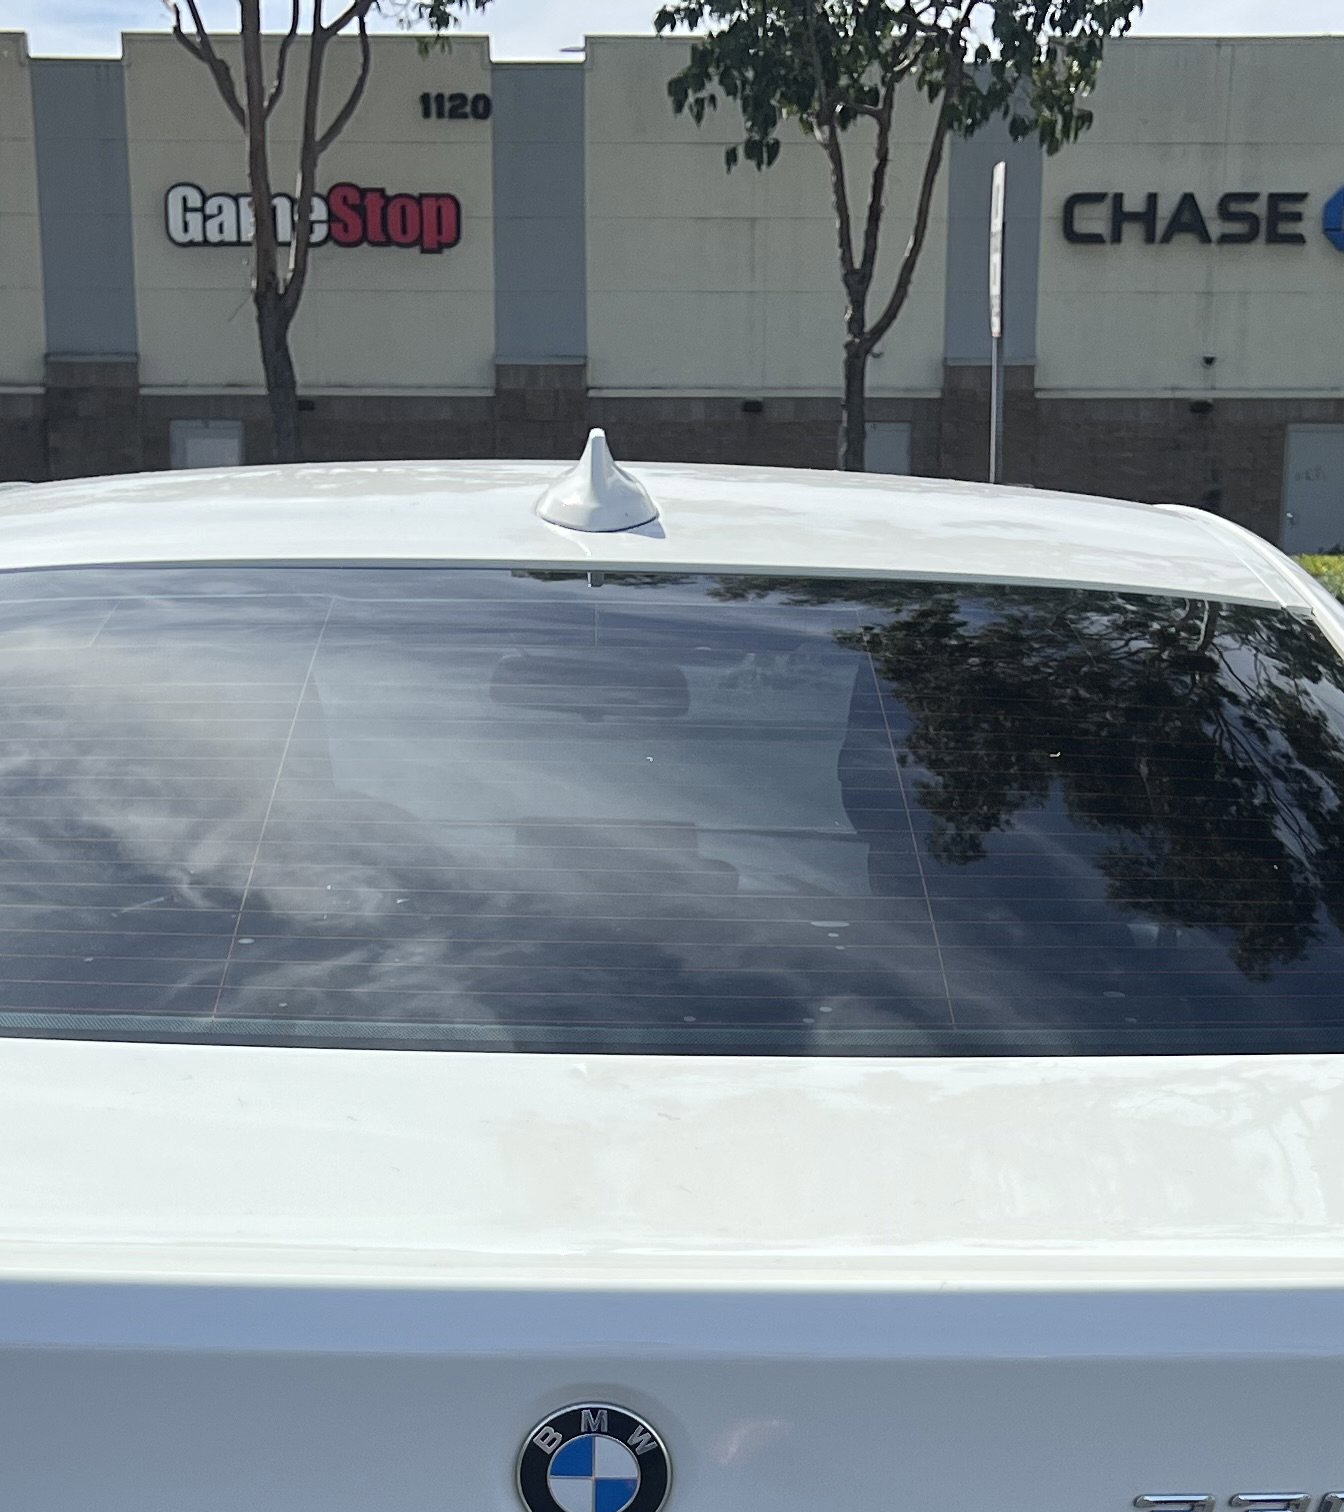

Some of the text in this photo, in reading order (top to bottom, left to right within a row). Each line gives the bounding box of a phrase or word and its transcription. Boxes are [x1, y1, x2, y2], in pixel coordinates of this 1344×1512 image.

[419, 92, 492, 120] 1120
[1062, 191, 1309, 245] CHASE
[532, 1409, 658, 1456] BMW
